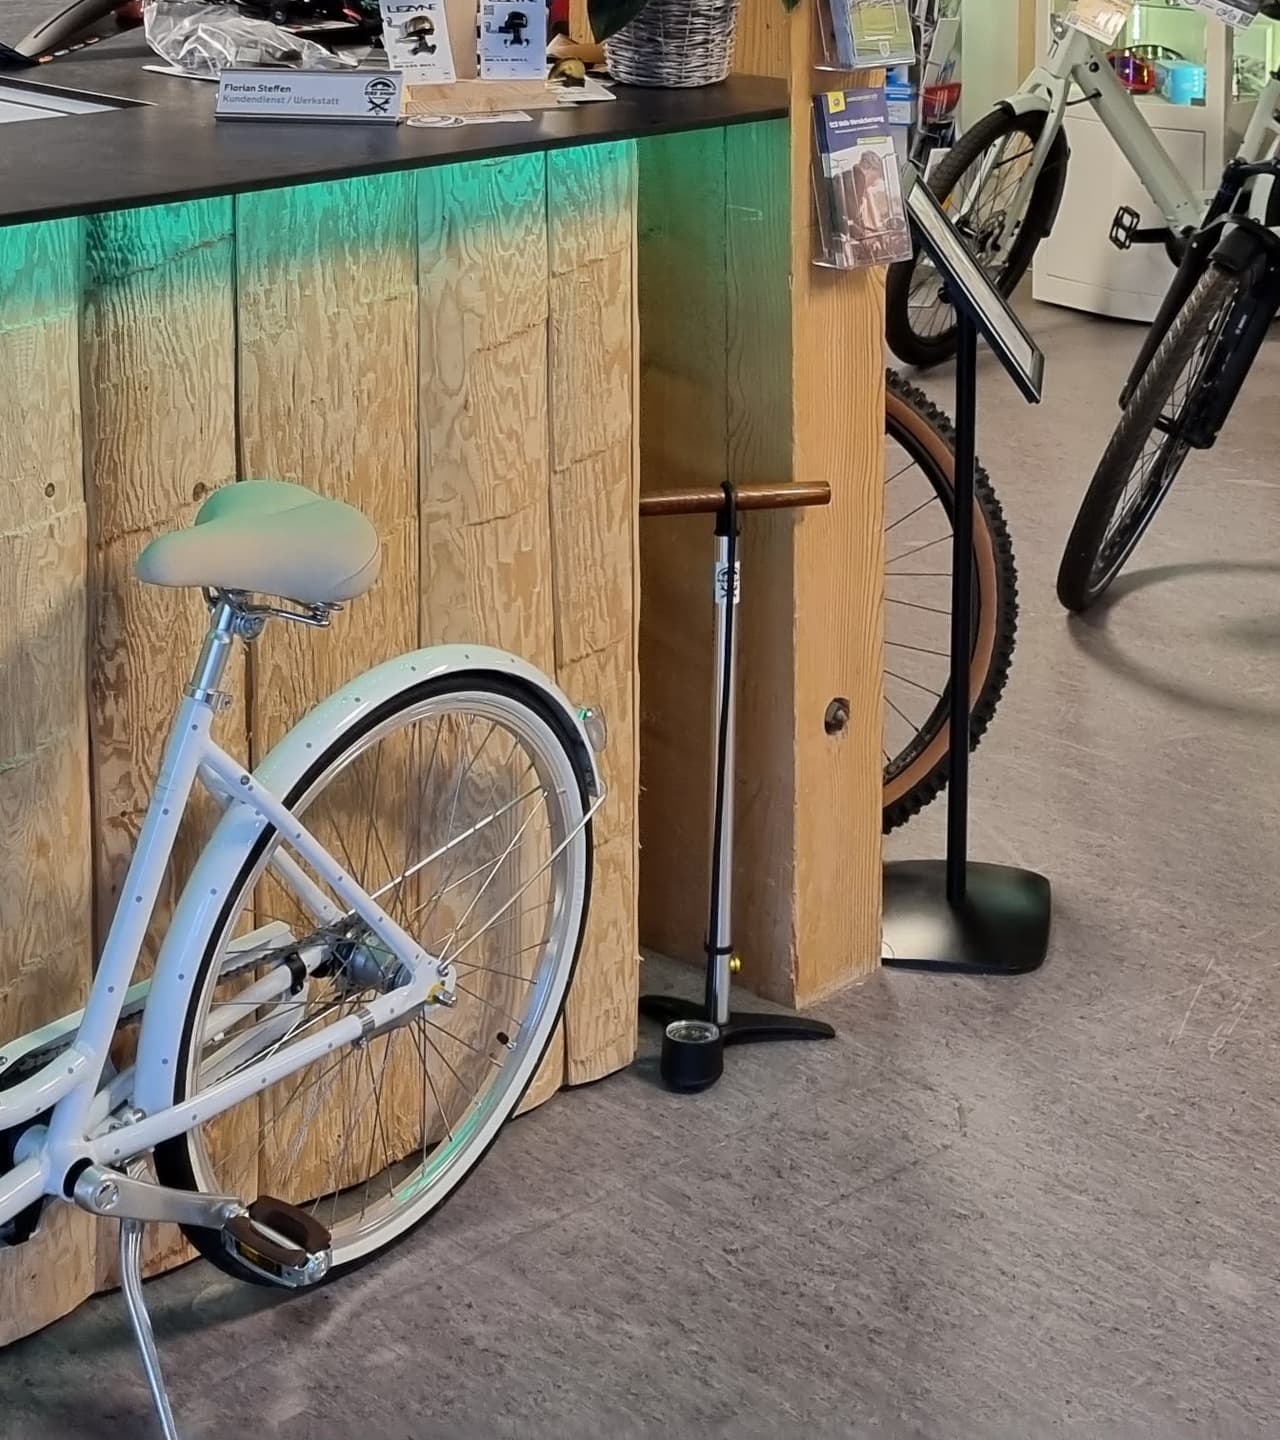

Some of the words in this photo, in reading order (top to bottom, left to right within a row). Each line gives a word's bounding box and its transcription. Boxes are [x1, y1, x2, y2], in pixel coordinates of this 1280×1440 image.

[386, 3, 437, 14] LEZYNE
[224, 83, 257, 93] Florian
[257, 84, 292, 94] Steffen
[222, 94, 286, 105] Kundendienst
[293, 96, 340, 106] Werkstatt
